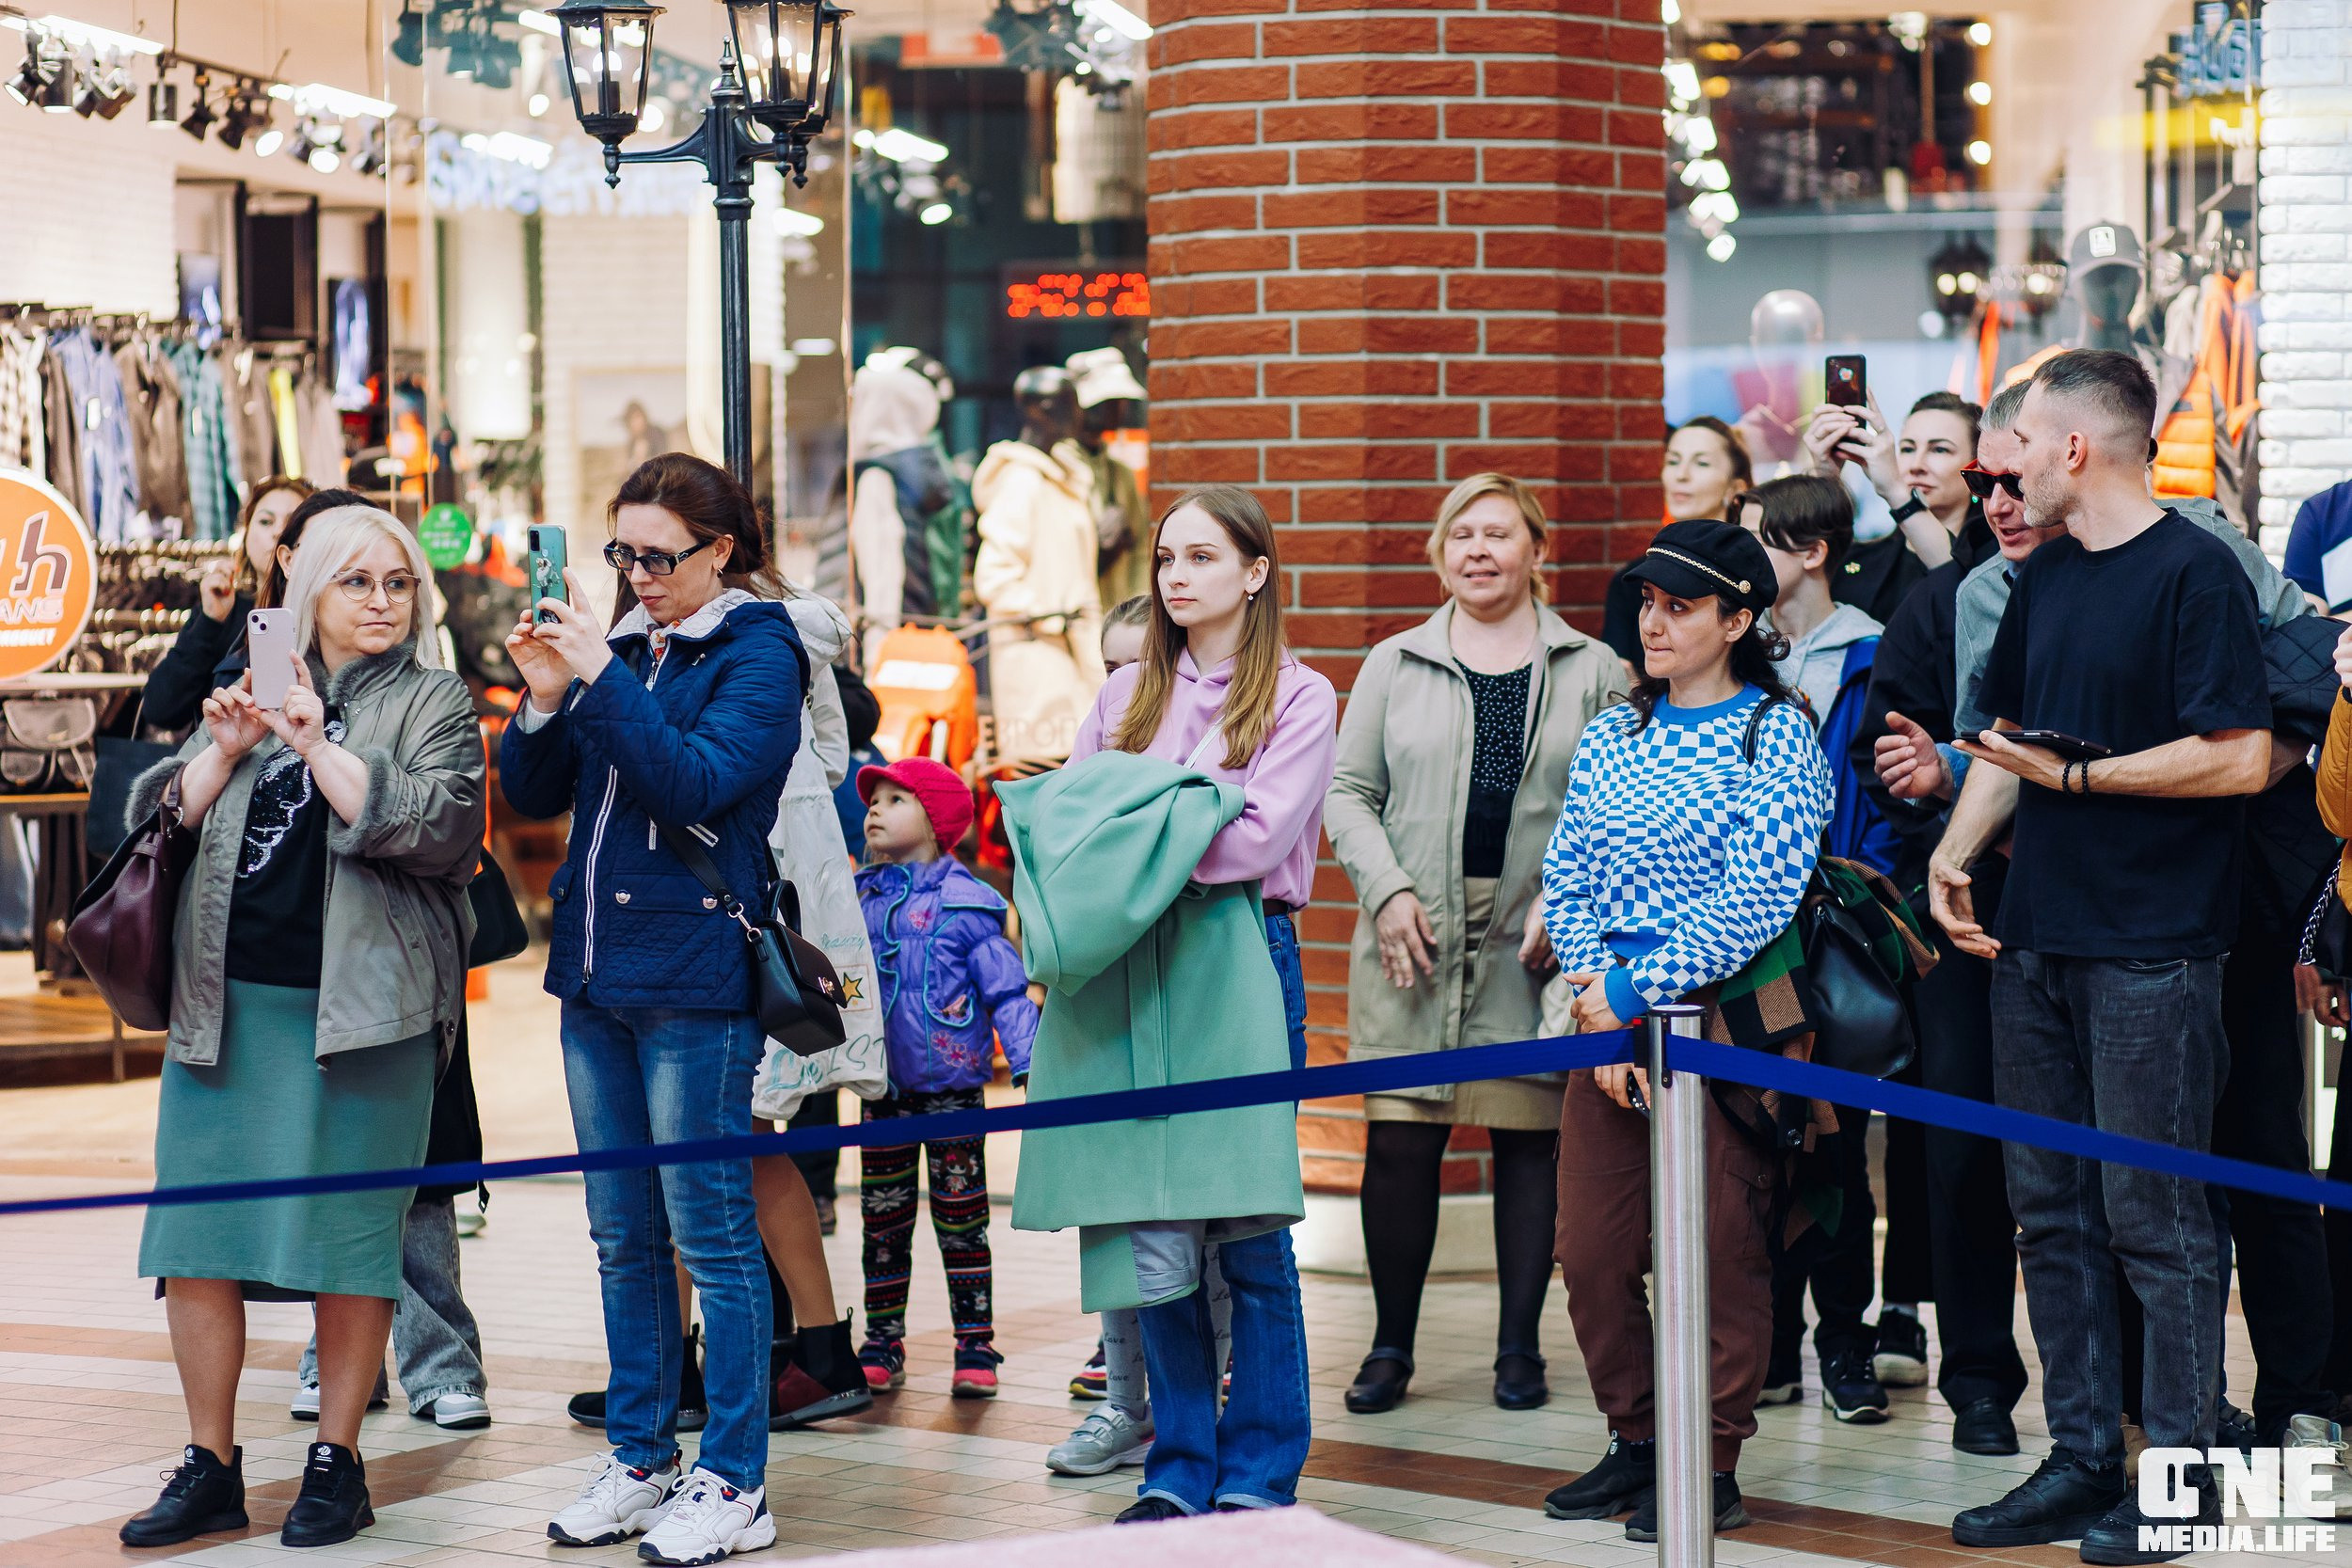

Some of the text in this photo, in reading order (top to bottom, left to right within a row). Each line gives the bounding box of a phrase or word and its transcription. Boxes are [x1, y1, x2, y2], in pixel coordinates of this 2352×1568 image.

[0, 511, 72, 598] h
[1104, 1331, 1126, 1344] Love
[1108, 1370, 1130, 1382] Love
